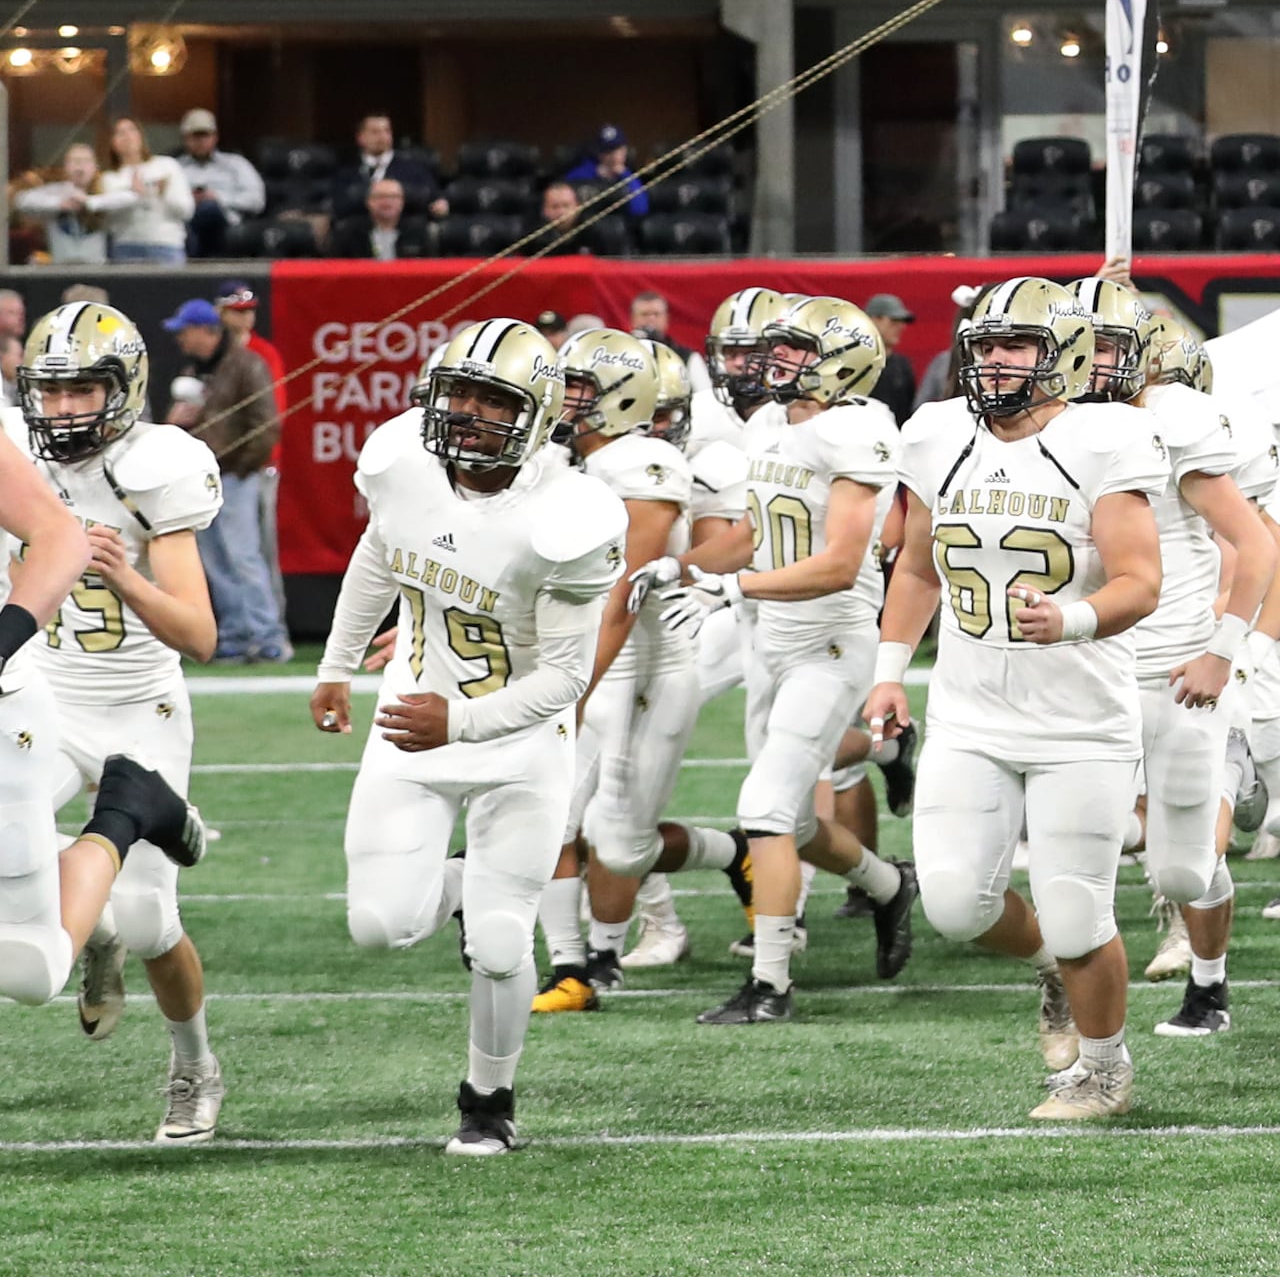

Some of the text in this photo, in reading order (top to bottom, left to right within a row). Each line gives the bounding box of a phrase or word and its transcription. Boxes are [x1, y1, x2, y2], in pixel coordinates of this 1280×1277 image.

[592, 347, 645, 372] Jackets
[937, 490, 1071, 523] CALHOUN
[390, 547, 501, 613] ALHOUN
[935, 523, 1075, 643] 62
